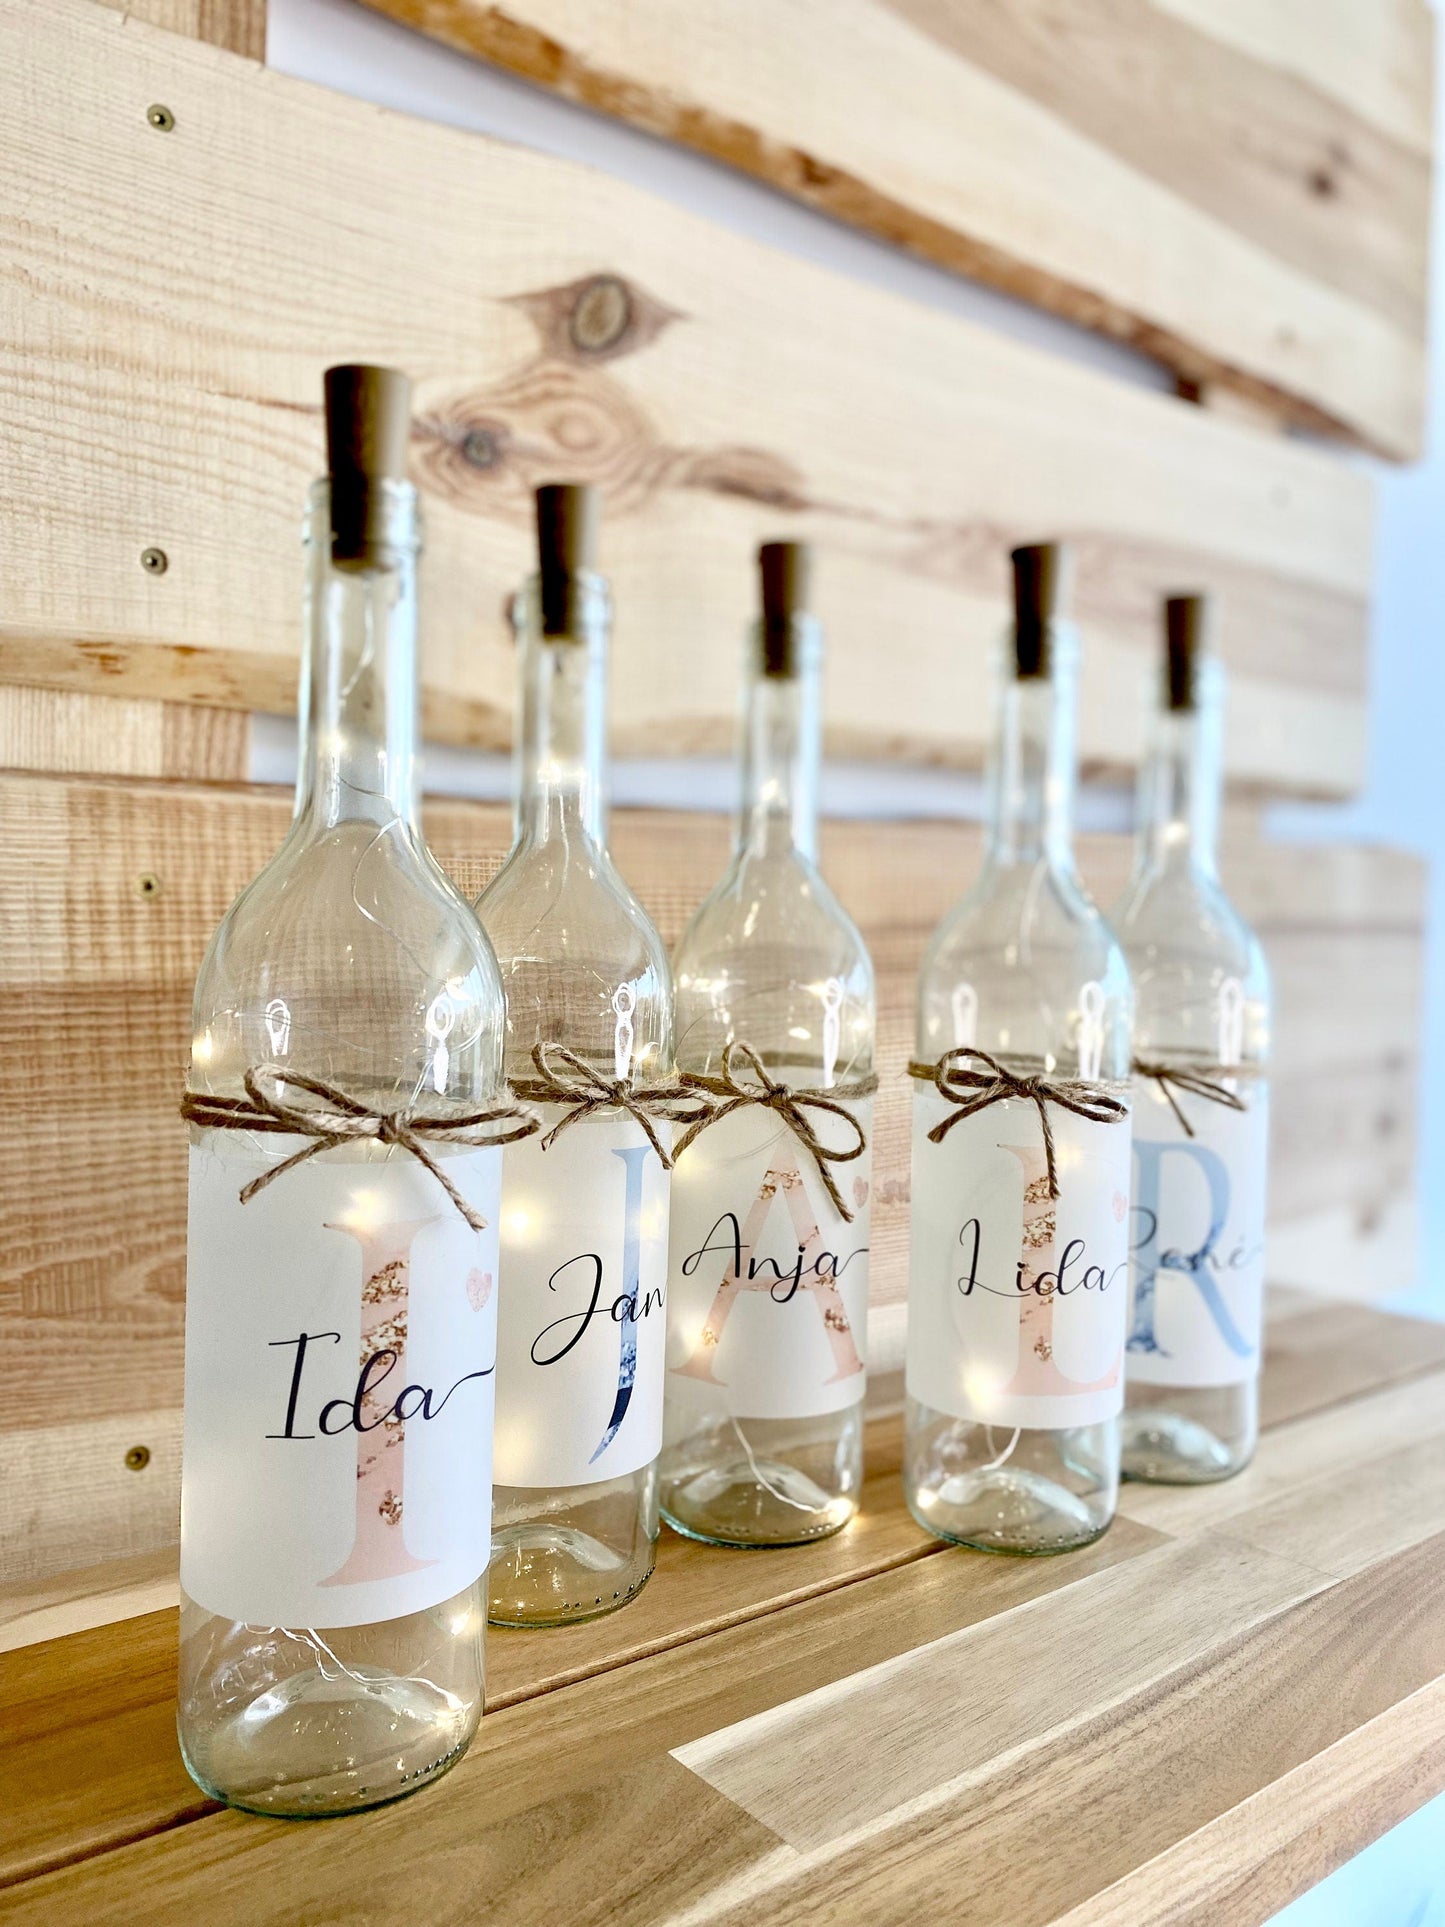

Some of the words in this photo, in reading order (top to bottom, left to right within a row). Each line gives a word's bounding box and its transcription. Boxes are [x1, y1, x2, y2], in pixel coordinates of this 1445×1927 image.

[682, 1212, 869, 1303] Anja
[958, 1218, 1127, 1298] Lida
[531, 1253, 668, 1366] Jan
[265, 1332, 496, 1440] Ida
